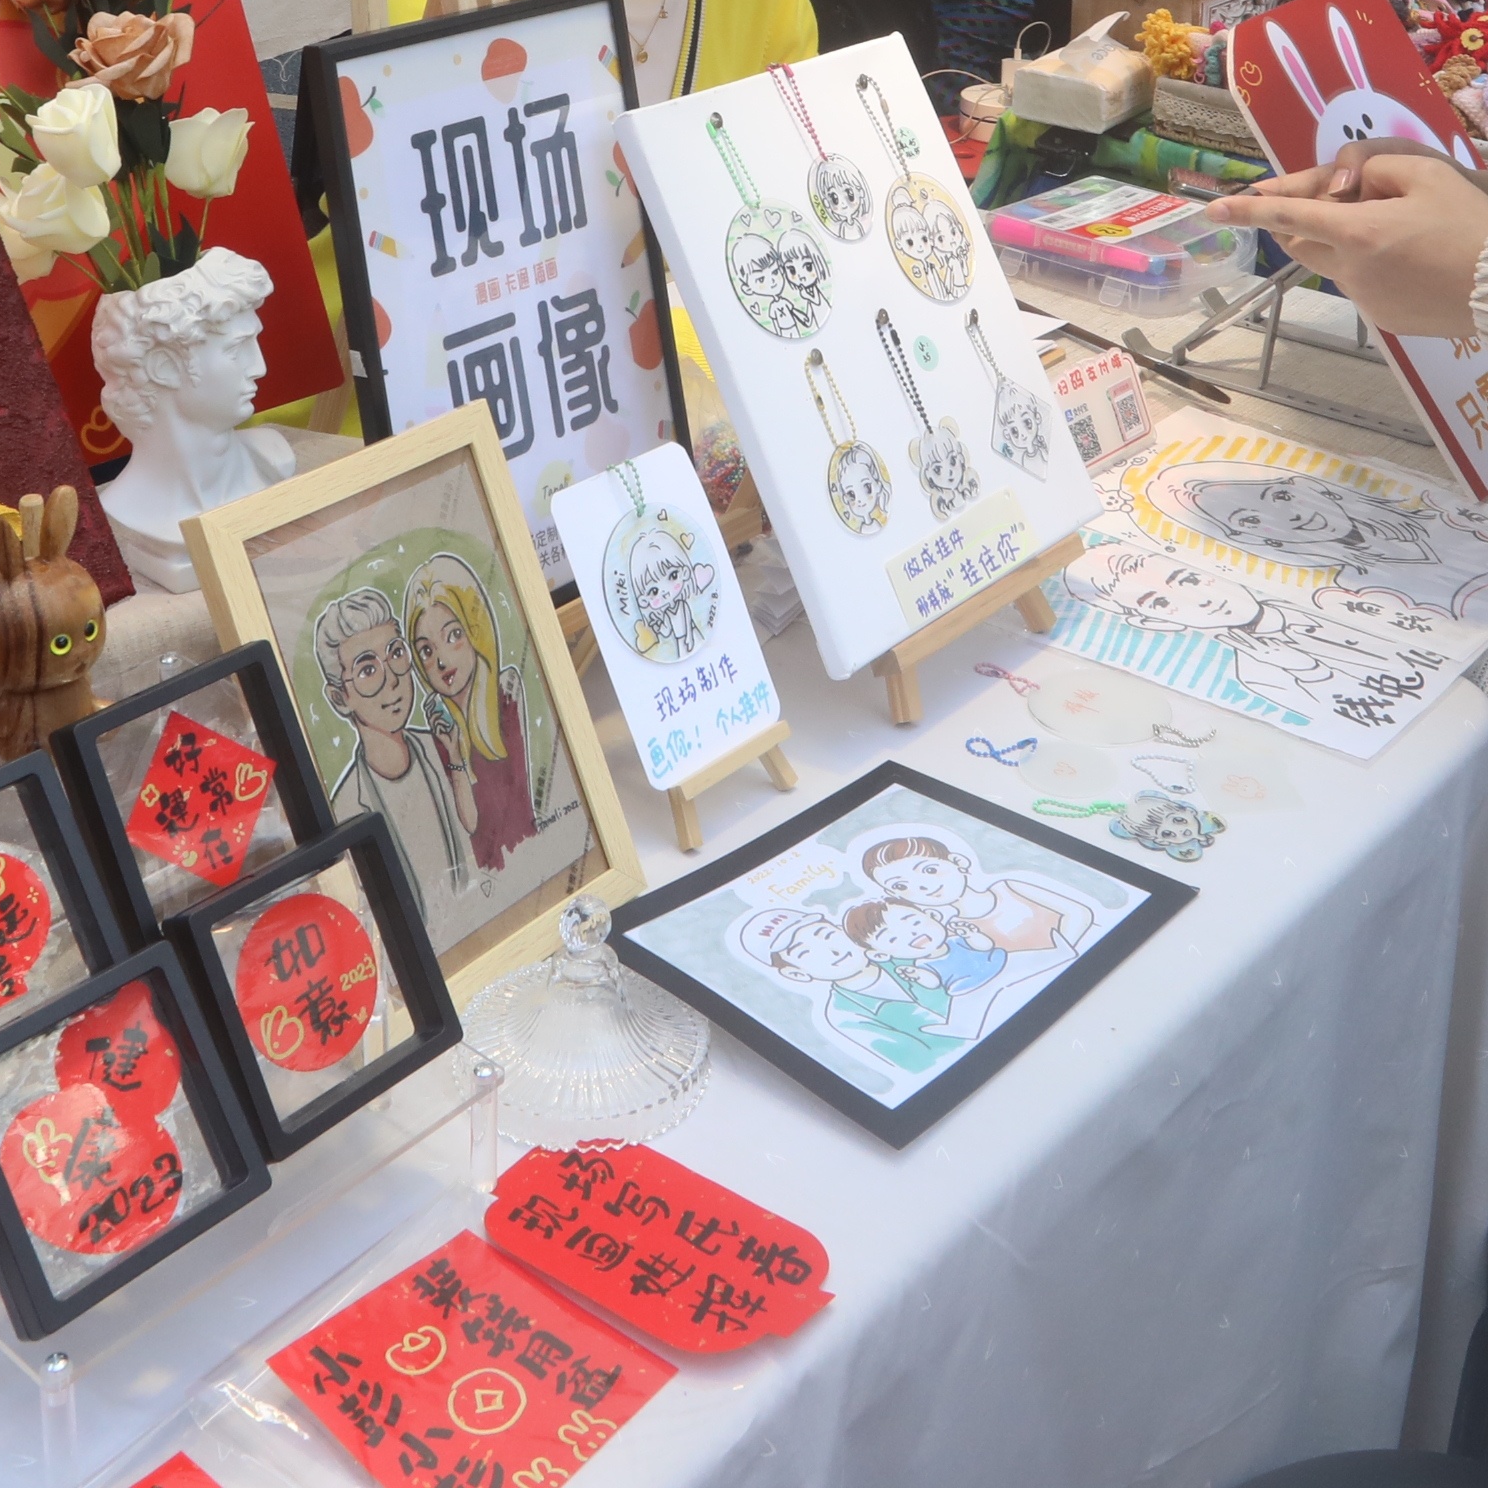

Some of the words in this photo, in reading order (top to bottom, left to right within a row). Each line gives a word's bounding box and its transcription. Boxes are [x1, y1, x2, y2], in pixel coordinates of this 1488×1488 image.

[411, 93, 588, 277] 现场
[505, 267, 531, 294] 卡通
[442, 289, 618, 460] 画像
[614, 570, 631, 615] Miki
[654, 653, 738, 722] 现场制作
[263, 922, 352, 1048] 如意
[339, 955, 376, 992] 2023
[62, 1020, 149, 1191] 健康
[78, 1151, 184, 1246] 2023
